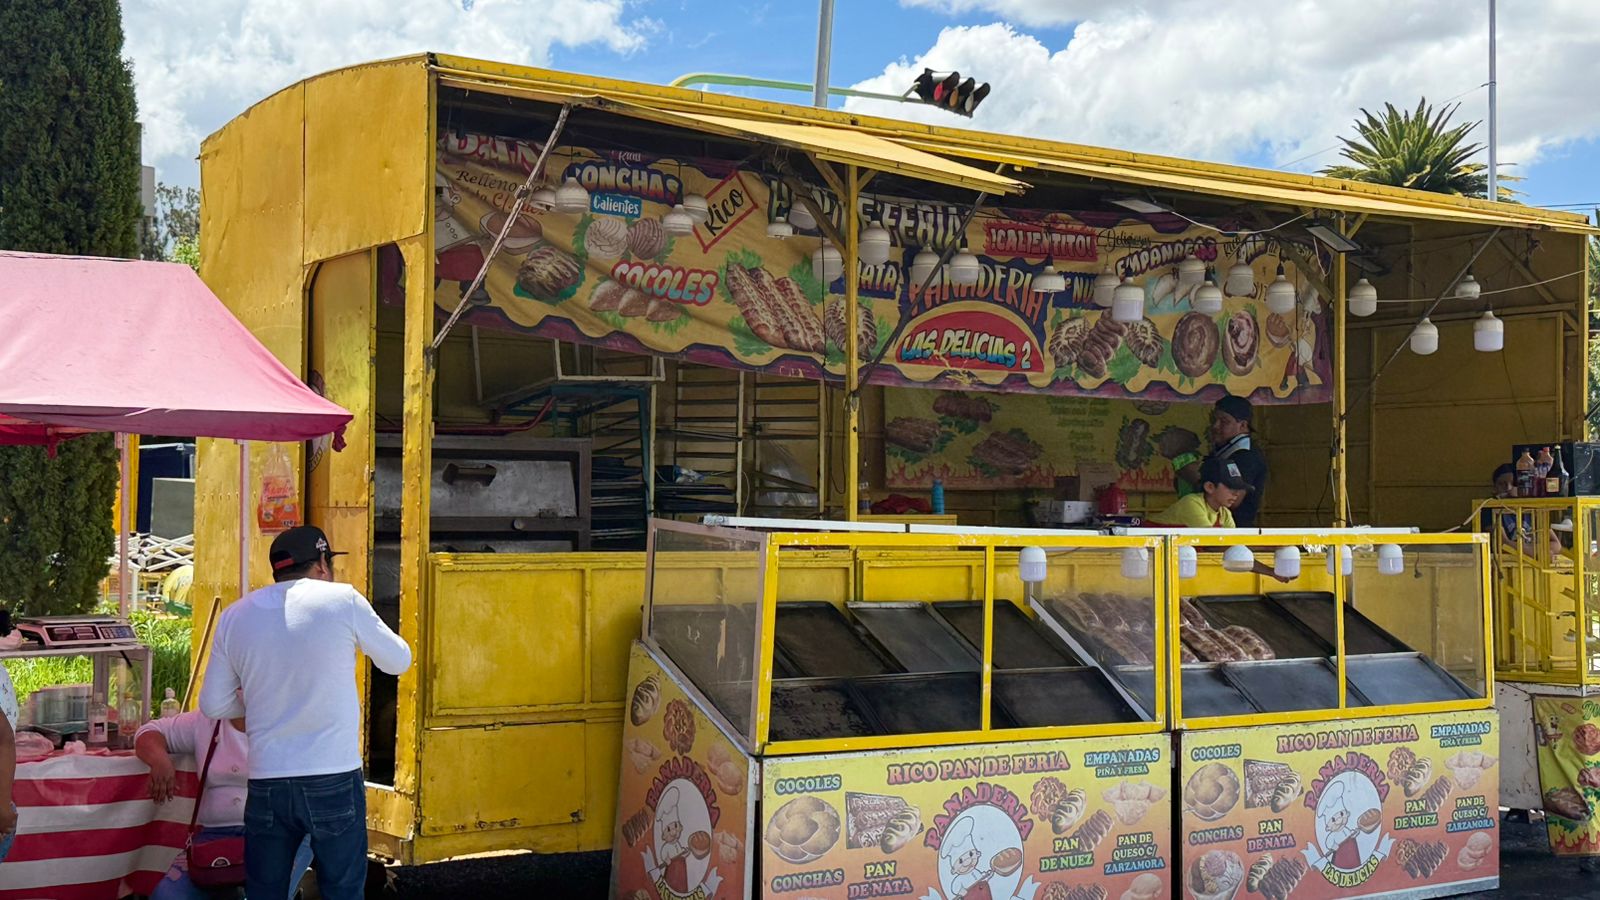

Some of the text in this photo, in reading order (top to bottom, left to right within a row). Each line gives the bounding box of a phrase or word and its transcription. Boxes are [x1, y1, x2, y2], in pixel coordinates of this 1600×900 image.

[456, 170, 518, 192] Relleno
[592, 194, 640, 215] Calientes
[704, 189, 744, 237] Rico
[613, 262, 718, 304] COCOLES
[901, 329, 1032, 369] LAS DELICIAS 2
[1277, 724, 1419, 753] RICO PAN DE FERIA
[1430, 721, 1490, 738] EMPANADAS
[1084, 748, 1160, 767] EMPANADAS
[1191, 744, 1242, 761] COCOLES
[887, 751, 1071, 785] RICO PAN DE FERIA
[1096, 764, 1149, 778] PIÑA Y FRESA
[774, 773, 842, 795] COCOLES
[1304, 751, 1390, 810] PANADERIA
[1405, 798, 1427, 814] PAN
[1456, 795, 1485, 808] PAN DE
[924, 782, 1034, 850] PANADERIA
[1394, 812, 1439, 830] DE NUEZ
[1452, 806, 1489, 821] QUESO C/
[1258, 818, 1283, 835] PAN
[1446, 817, 1495, 833] ZARZAMORA
[1053, 837, 1080, 853] PAN
[1117, 832, 1153, 847] PAN DE
[1189, 826, 1244, 845] CONCHAS
[1247, 834, 1296, 853] DE NATA
[1040, 852, 1094, 872] DE NUEZ
[1112, 844, 1157, 862] QUESO C/
[864, 858, 897, 880] PAN
[1104, 857, 1166, 875] ZARZAMORA
[1321, 855, 1380, 887] LAS DELICIAS
[771, 868, 844, 892] CONCHAS
[848, 877, 914, 899] DE NATA
